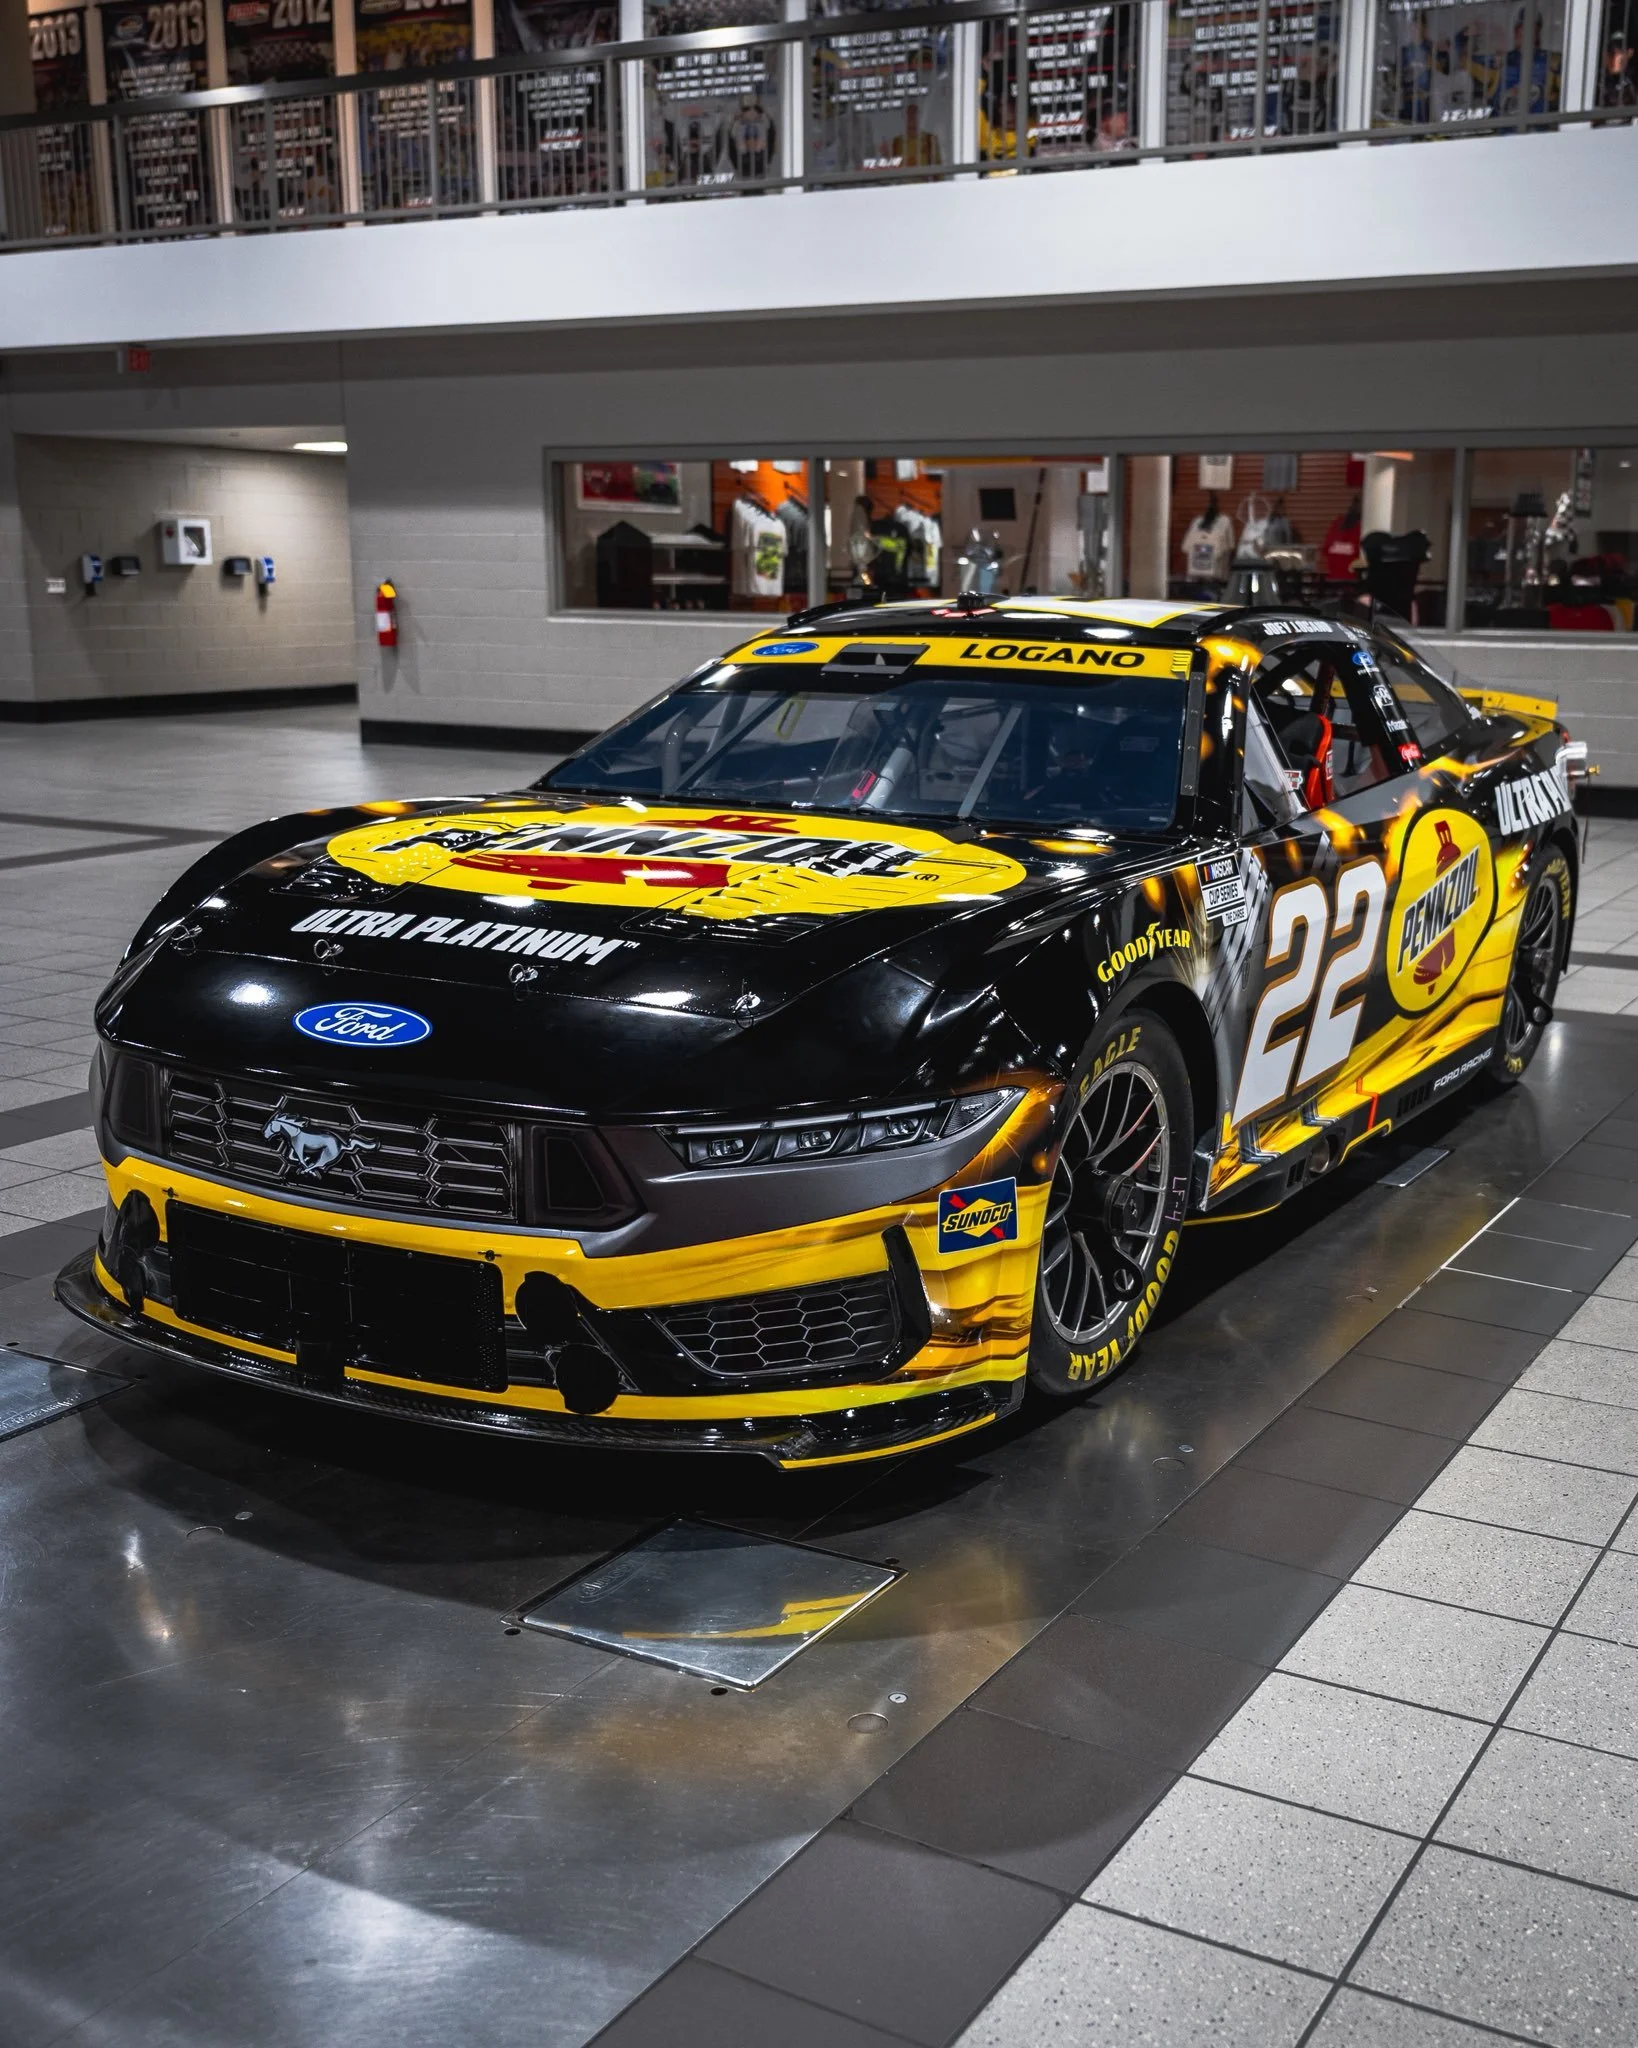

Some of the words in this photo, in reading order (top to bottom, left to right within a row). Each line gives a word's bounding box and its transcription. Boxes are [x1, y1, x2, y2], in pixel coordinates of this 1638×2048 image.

[29, 13, 81, 61] 2013
[147, 2, 206, 49] 2013
[1262, 621, 1292, 636] JOEY
[959, 643, 1145, 669] LOGANO
[1494, 774, 1556, 836] ULTRA
[1210, 859, 1234, 880] NASCAR
[1208, 887, 1221, 906] CUP
[1220, 882, 1239, 902] SERIES
[1397, 852, 1478, 974] PENNZOIL
[290, 909, 418, 938] ULTRA
[1097, 922, 1191, 983] GOODYEAR
[1231, 857, 1388, 1130] 22
[315, 1007, 407, 1042] Ford
[1080, 1026, 1142, 1099] EAGLE
[1433, 1067, 1460, 1091] FORD
[1460, 1047, 1493, 1074] RACING
[945, 1204, 1011, 1232] SUNOCO
[1068, 1229, 1180, 1381] GOODYEAR
